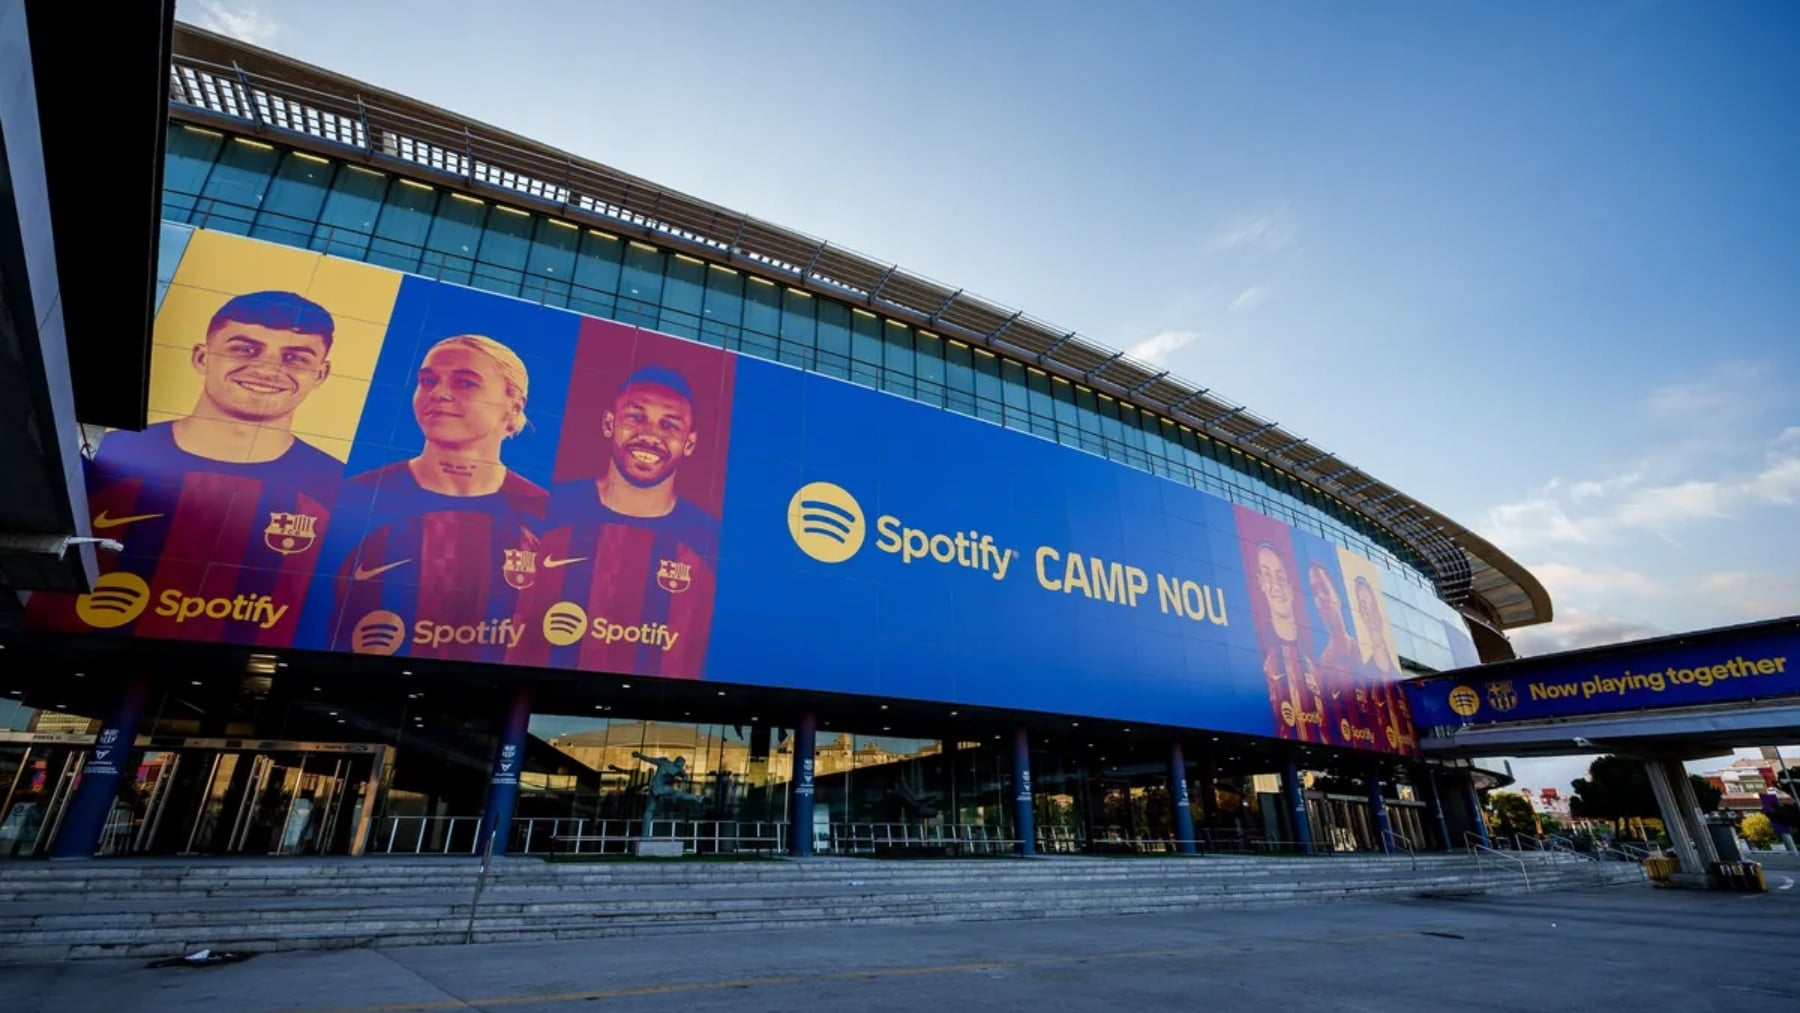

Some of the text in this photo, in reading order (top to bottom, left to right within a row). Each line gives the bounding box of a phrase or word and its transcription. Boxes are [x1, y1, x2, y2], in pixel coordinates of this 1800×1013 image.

[875, 514, 1228, 627] Spotify CAMP NOU
[154, 589, 289, 629] Spotify
[413, 618, 526, 649] Spotify
[591, 617, 679, 651] Spotify
[1528, 656, 1787, 701] Now playing together
